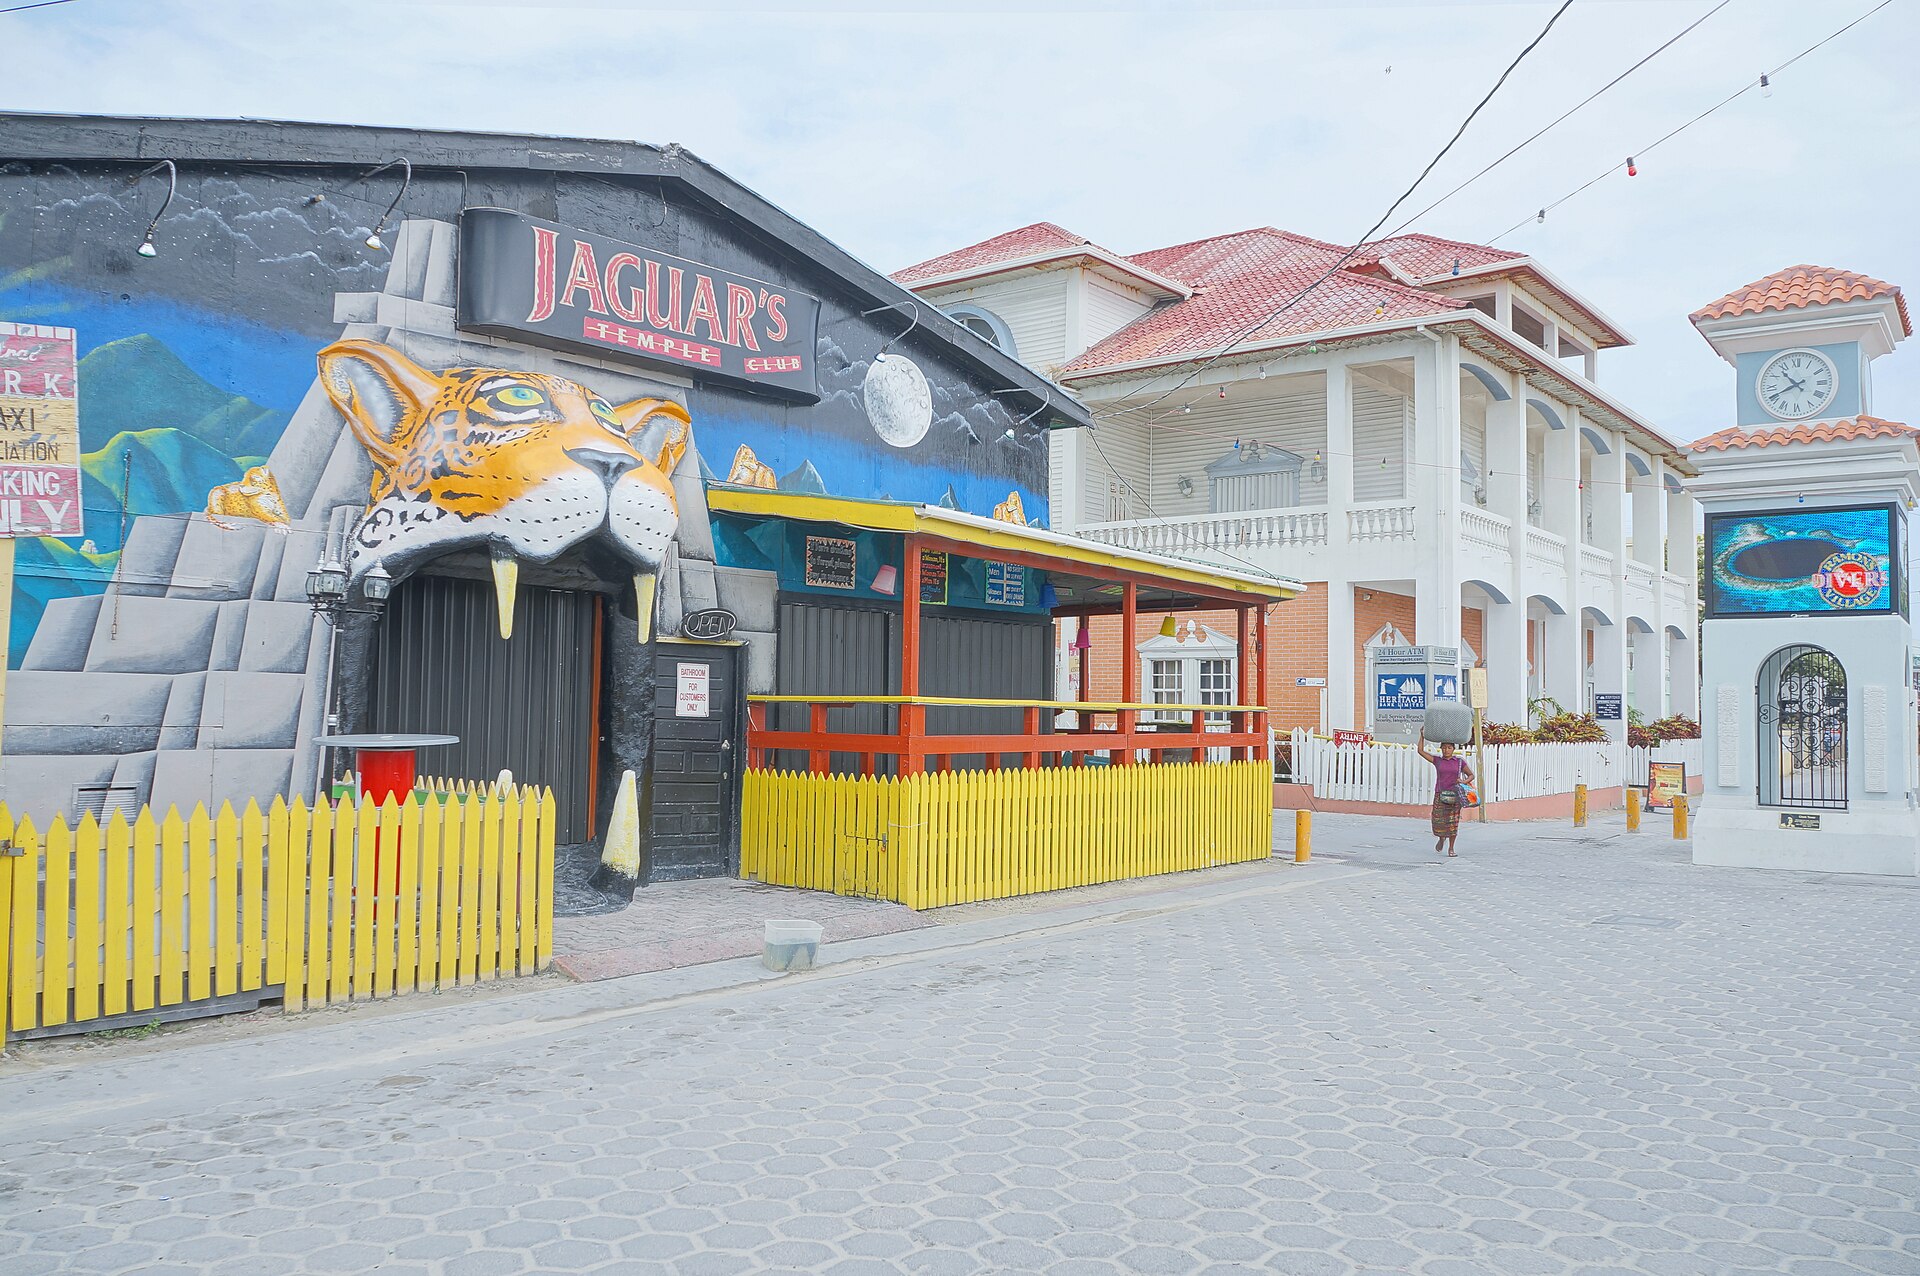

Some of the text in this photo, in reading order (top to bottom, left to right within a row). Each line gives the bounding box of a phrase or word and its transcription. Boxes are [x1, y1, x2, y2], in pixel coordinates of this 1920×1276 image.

[526, 226, 787, 351] JAGUAR'S
[598, 323, 711, 362] TEMPLE
[747, 358, 801, 371] CLUB
[0, 439, 58, 461] IATION
[0, 471, 60, 496] KING
[1811, 570, 1889, 588] DIVERS
[687, 613, 732, 636] OPEN
[1378, 647, 1424, 656] 24 Hour ATM
[681, 668, 706, 677] BATHROOM
[688, 682, 698, 691] FOR
[680, 692, 706, 702] CUSTOMERS
[1379, 695, 1424, 703] HERITAGE
[686, 703, 698, 711] ONLY
[1340, 733, 1364, 742] ENTRY
